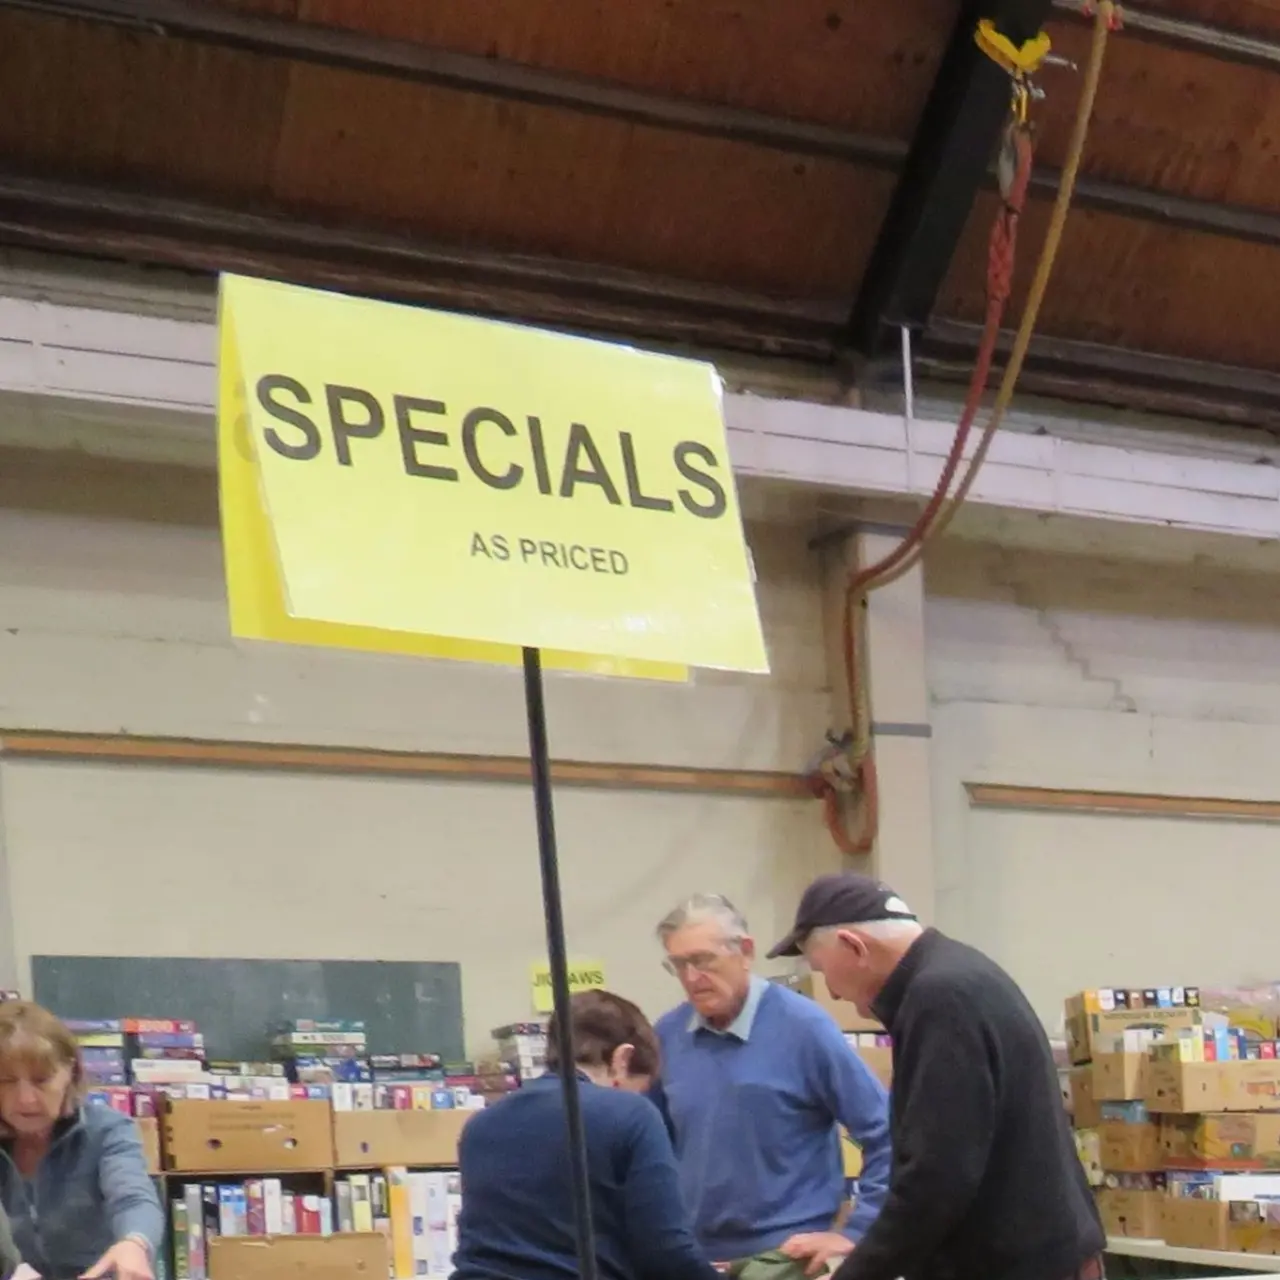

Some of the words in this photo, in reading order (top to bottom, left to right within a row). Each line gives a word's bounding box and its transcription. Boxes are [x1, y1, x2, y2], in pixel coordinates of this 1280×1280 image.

[254, 373, 728, 520] SPECIALS
[469, 531, 511, 562] AS
[518, 537, 629, 578] PRICED
